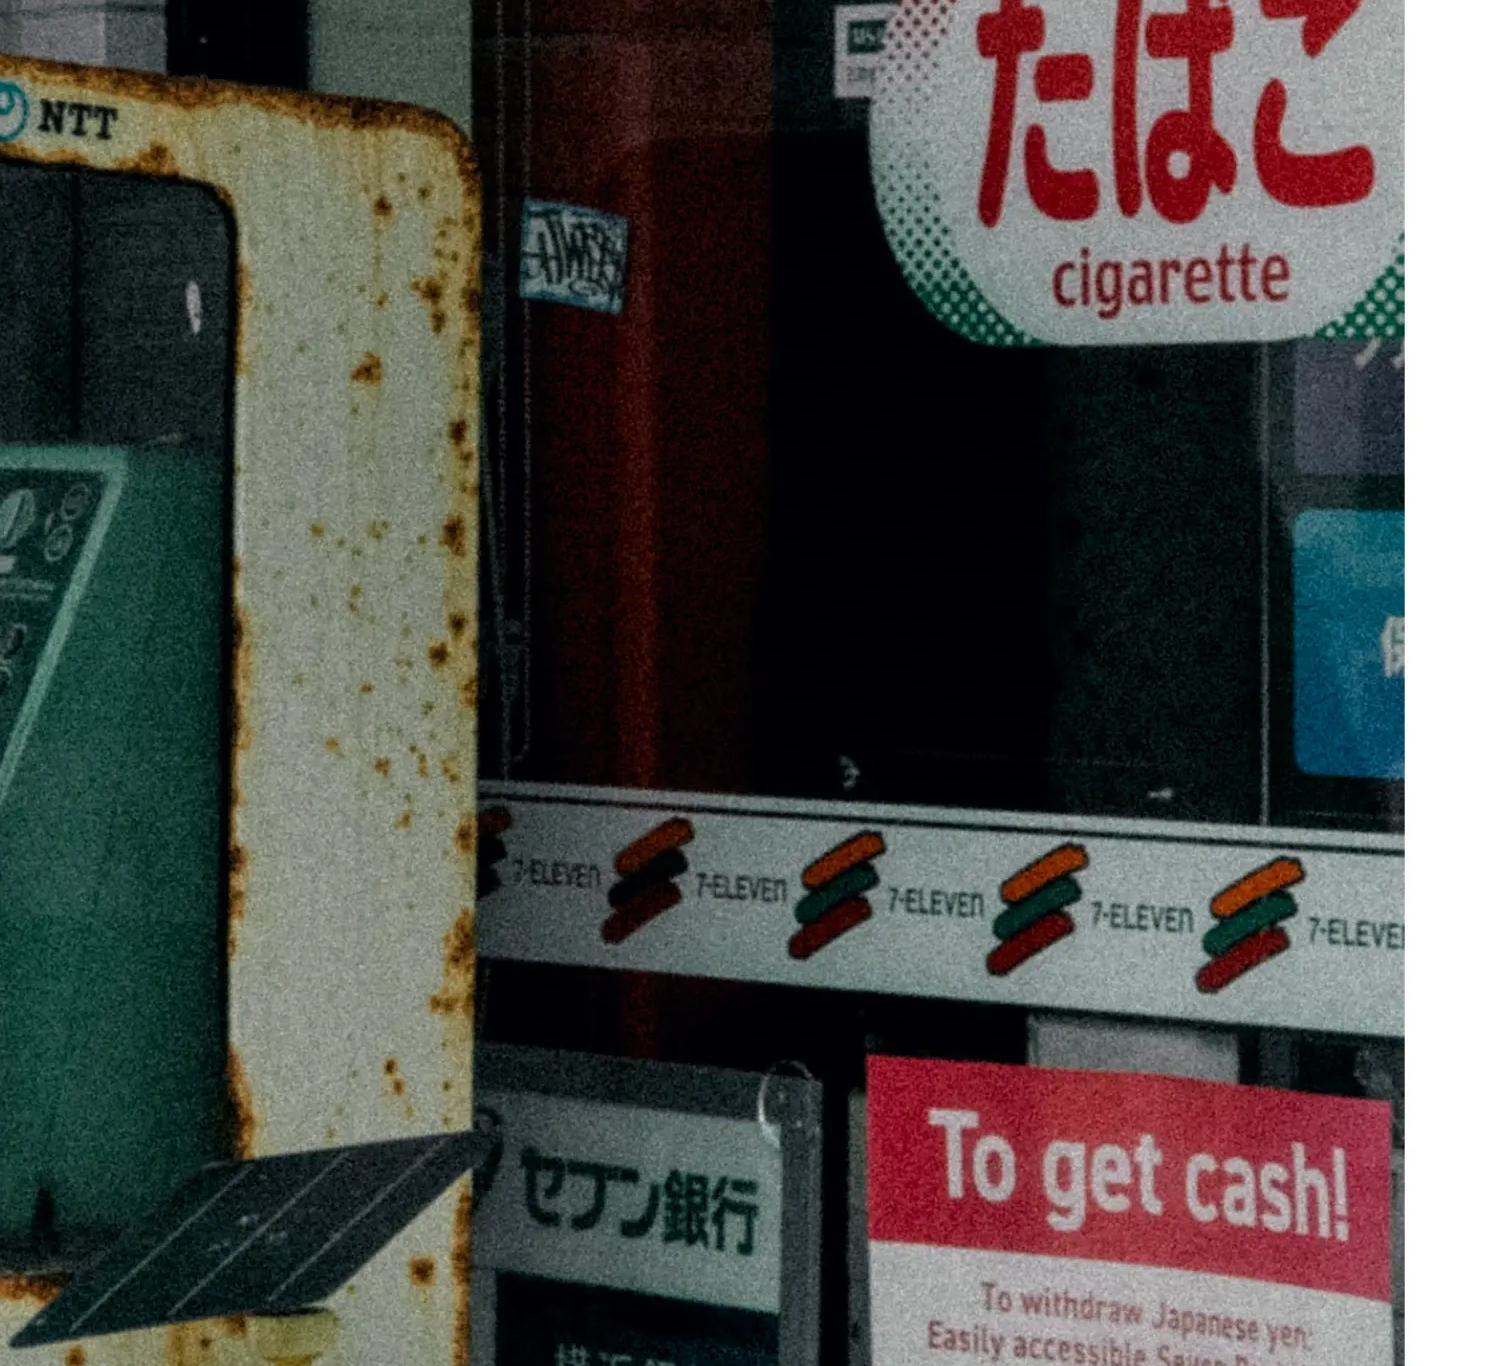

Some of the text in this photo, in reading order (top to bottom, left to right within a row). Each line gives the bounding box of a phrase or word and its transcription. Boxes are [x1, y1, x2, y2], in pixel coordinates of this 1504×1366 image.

[38, 99, 118, 140] NTT
[1053, 243, 1290, 319] cigarette
[521, 1145, 759, 1256] セブン銀行
[928, 1106, 1350, 1243] To get cash!
[928, 1320, 1007, 1365] Easily
[981, 1280, 1013, 1313] To
[1020, 1288, 1143, 1326] withdraw
[1152, 1301, 1259, 1344] Japanese
